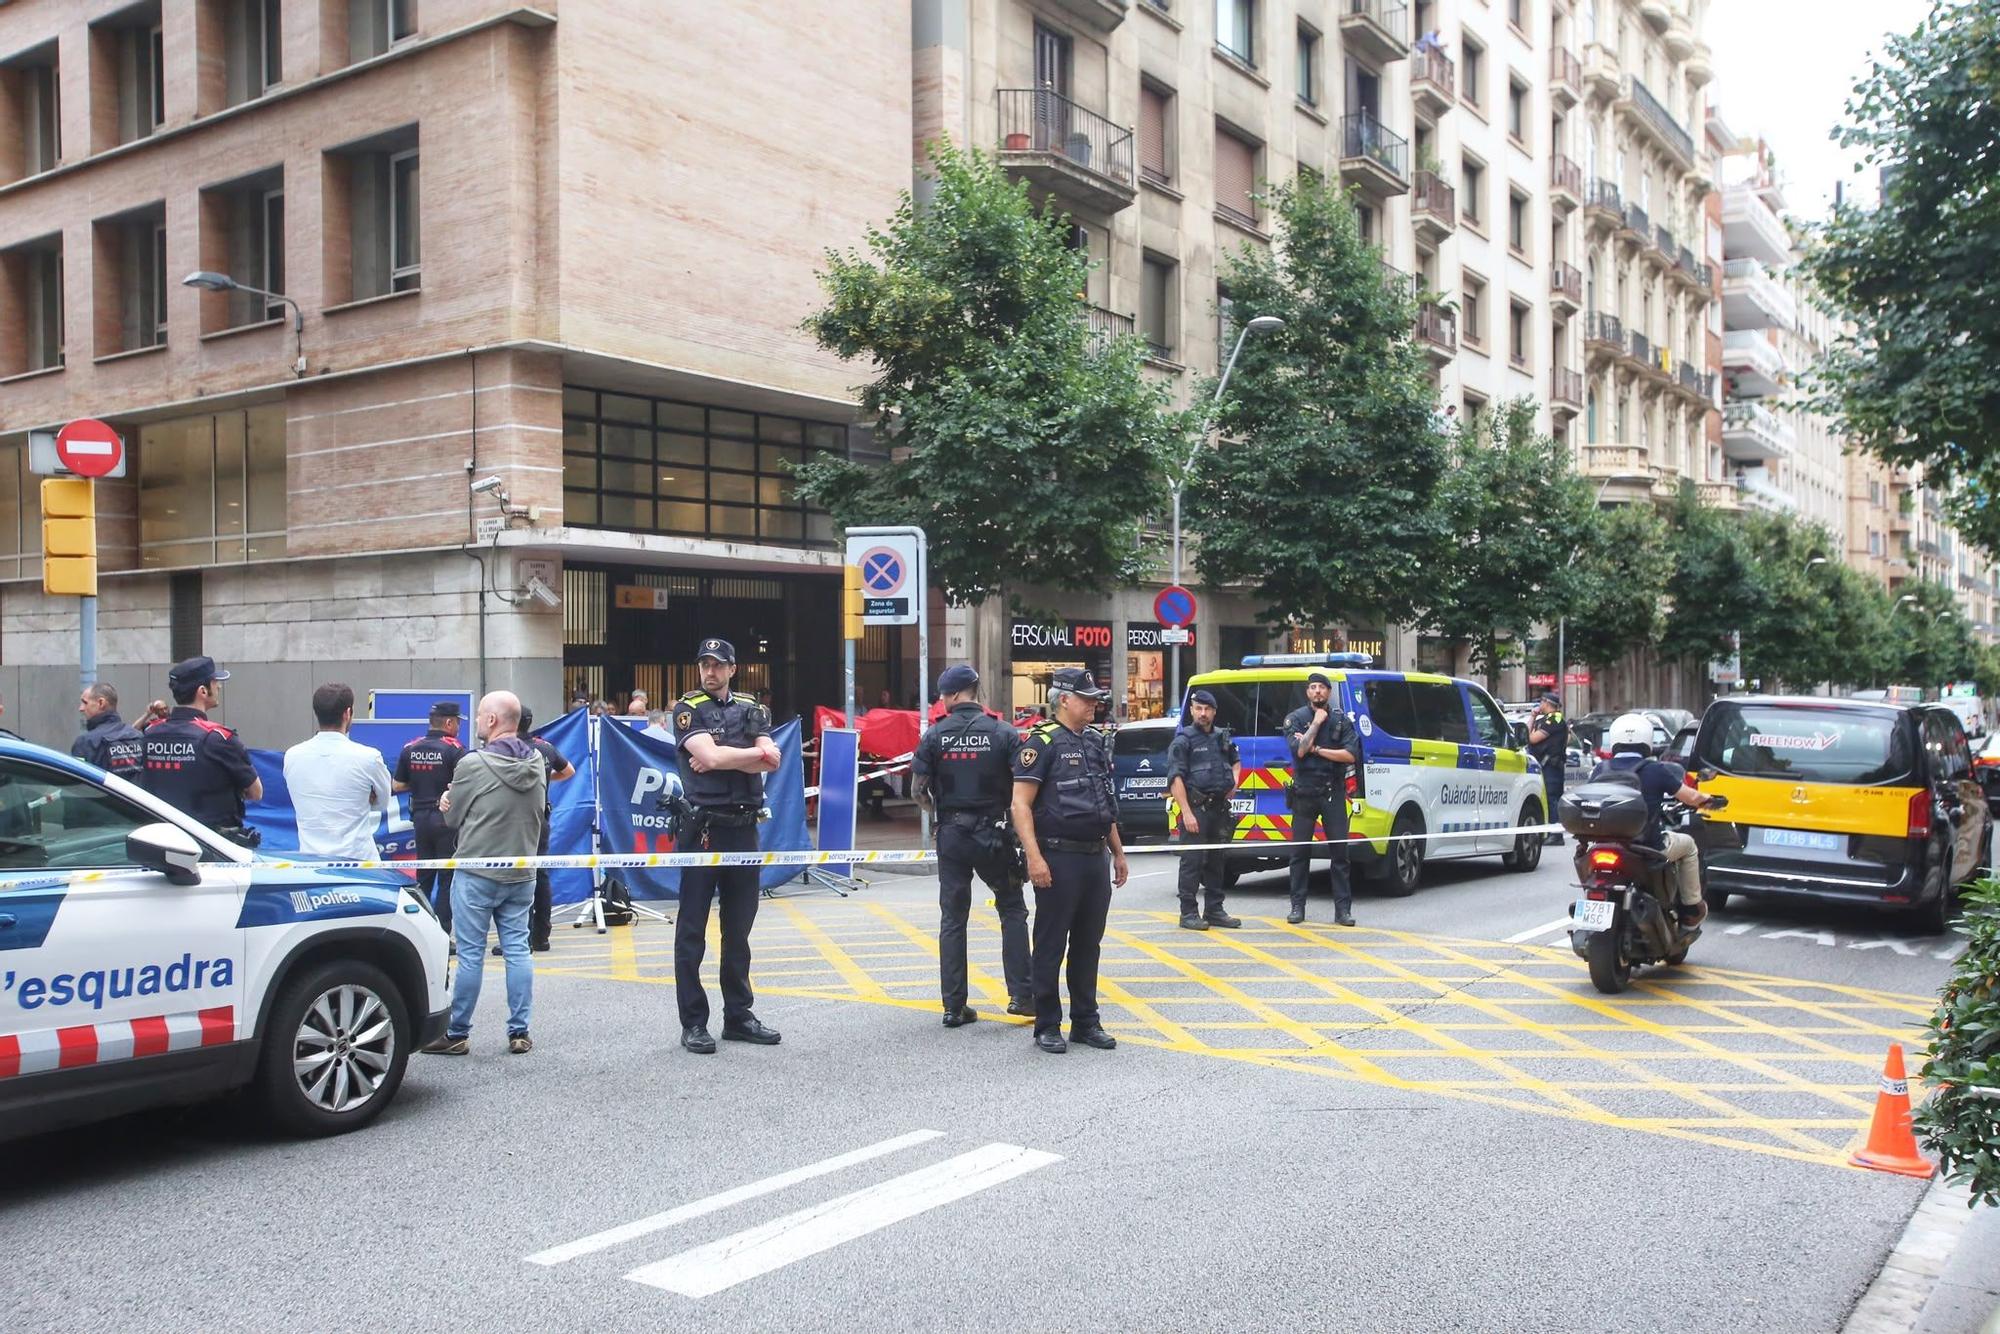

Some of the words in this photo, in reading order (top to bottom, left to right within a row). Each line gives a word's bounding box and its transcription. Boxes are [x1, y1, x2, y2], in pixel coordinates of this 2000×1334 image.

[1012, 624, 1073, 646] ERSONAL
[1075, 626, 1112, 647] FOTO
[1128, 629, 1162, 646] PERSON
[1751, 734, 1816, 748] FREENOW
[109, 743, 142, 756] POLICIA
[147, 742, 195, 754] POLICIA
[410, 751, 443, 760] POLICIA
[1367, 765, 1390, 774] Barcelona
[1119, 792, 1164, 800] POLICIA
[1441, 784, 1475, 805] Guàrdia
[1478, 785, 1508, 805] Urbana
[1232, 802, 1252, 812] NFZ
